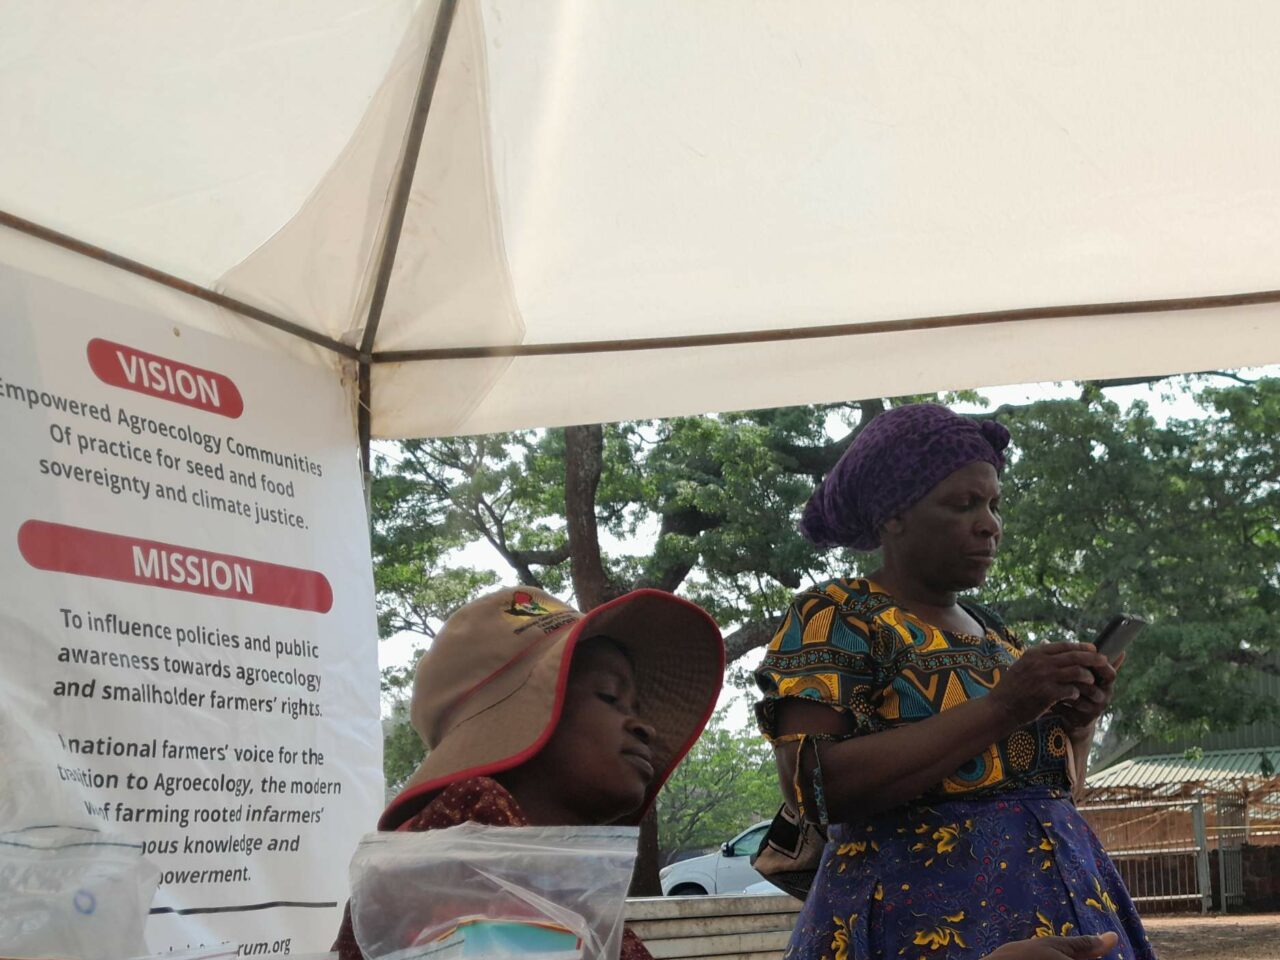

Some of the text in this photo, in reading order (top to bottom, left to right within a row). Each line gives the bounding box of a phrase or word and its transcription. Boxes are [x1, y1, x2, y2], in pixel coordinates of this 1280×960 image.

[116, 350, 221, 408] VISION
[50, 424, 296, 499] Of practice for seed and food
[117, 407, 222, 455] Agroecology
[226, 436, 323, 478] Communities
[39, 458, 310, 531] sovereignty and climate justice.
[132, 545, 254, 595] MISSION
[60, 608, 319, 659] To influence policies and public
[57, 646, 322, 693] awareness towards agroecology
[52, 678, 96, 699] and
[101, 683, 206, 708] smallholder
[281, 696, 323, 720] rights.
[67, 736, 157, 759] national
[234, 746, 274, 765] voice
[278, 747, 298, 765] for
[301, 748, 324, 766] the
[126, 773, 148, 790] to
[153, 772, 254, 797] Agroecology,
[261, 776, 286, 794] the
[290, 777, 341, 795] modern
[115, 803, 189, 828] farming
[193, 805, 242, 823] rooted
[183, 835, 262, 855] knowledge
[267, 835, 300, 852] and
